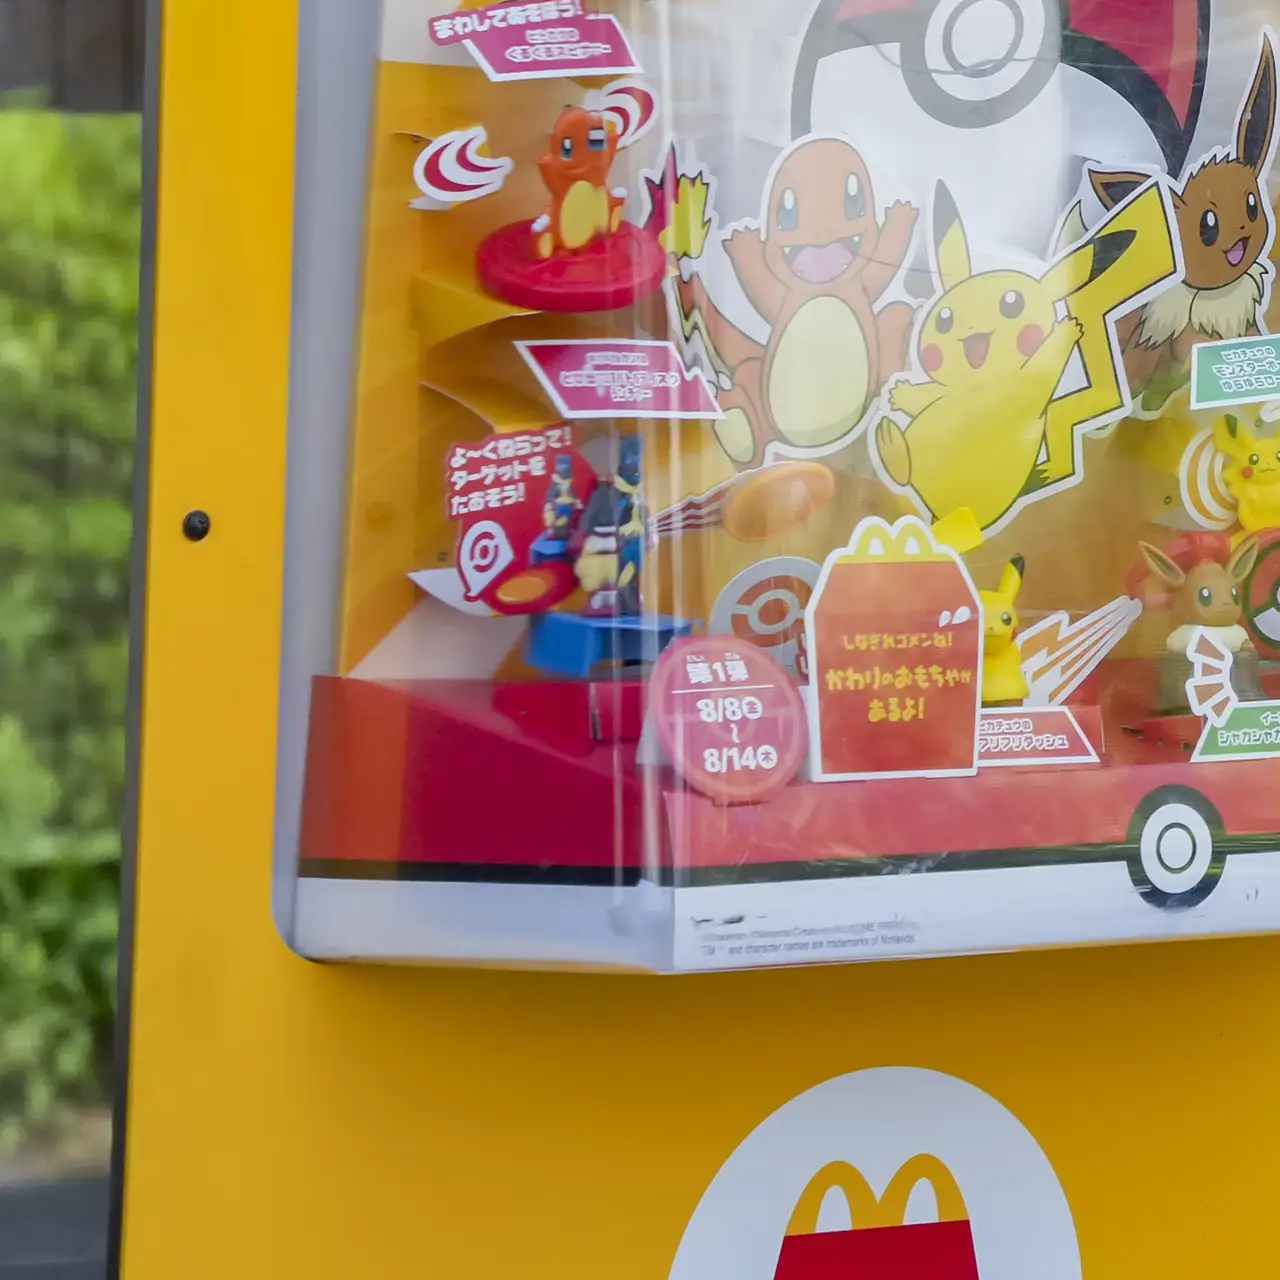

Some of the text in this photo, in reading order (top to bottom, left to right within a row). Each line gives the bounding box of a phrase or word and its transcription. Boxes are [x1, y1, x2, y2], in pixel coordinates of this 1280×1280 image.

[450, 455, 547, 491] ターゲットを
[686, 660, 750, 685] 第1弾
[866, 696, 925, 724] あるよ!
